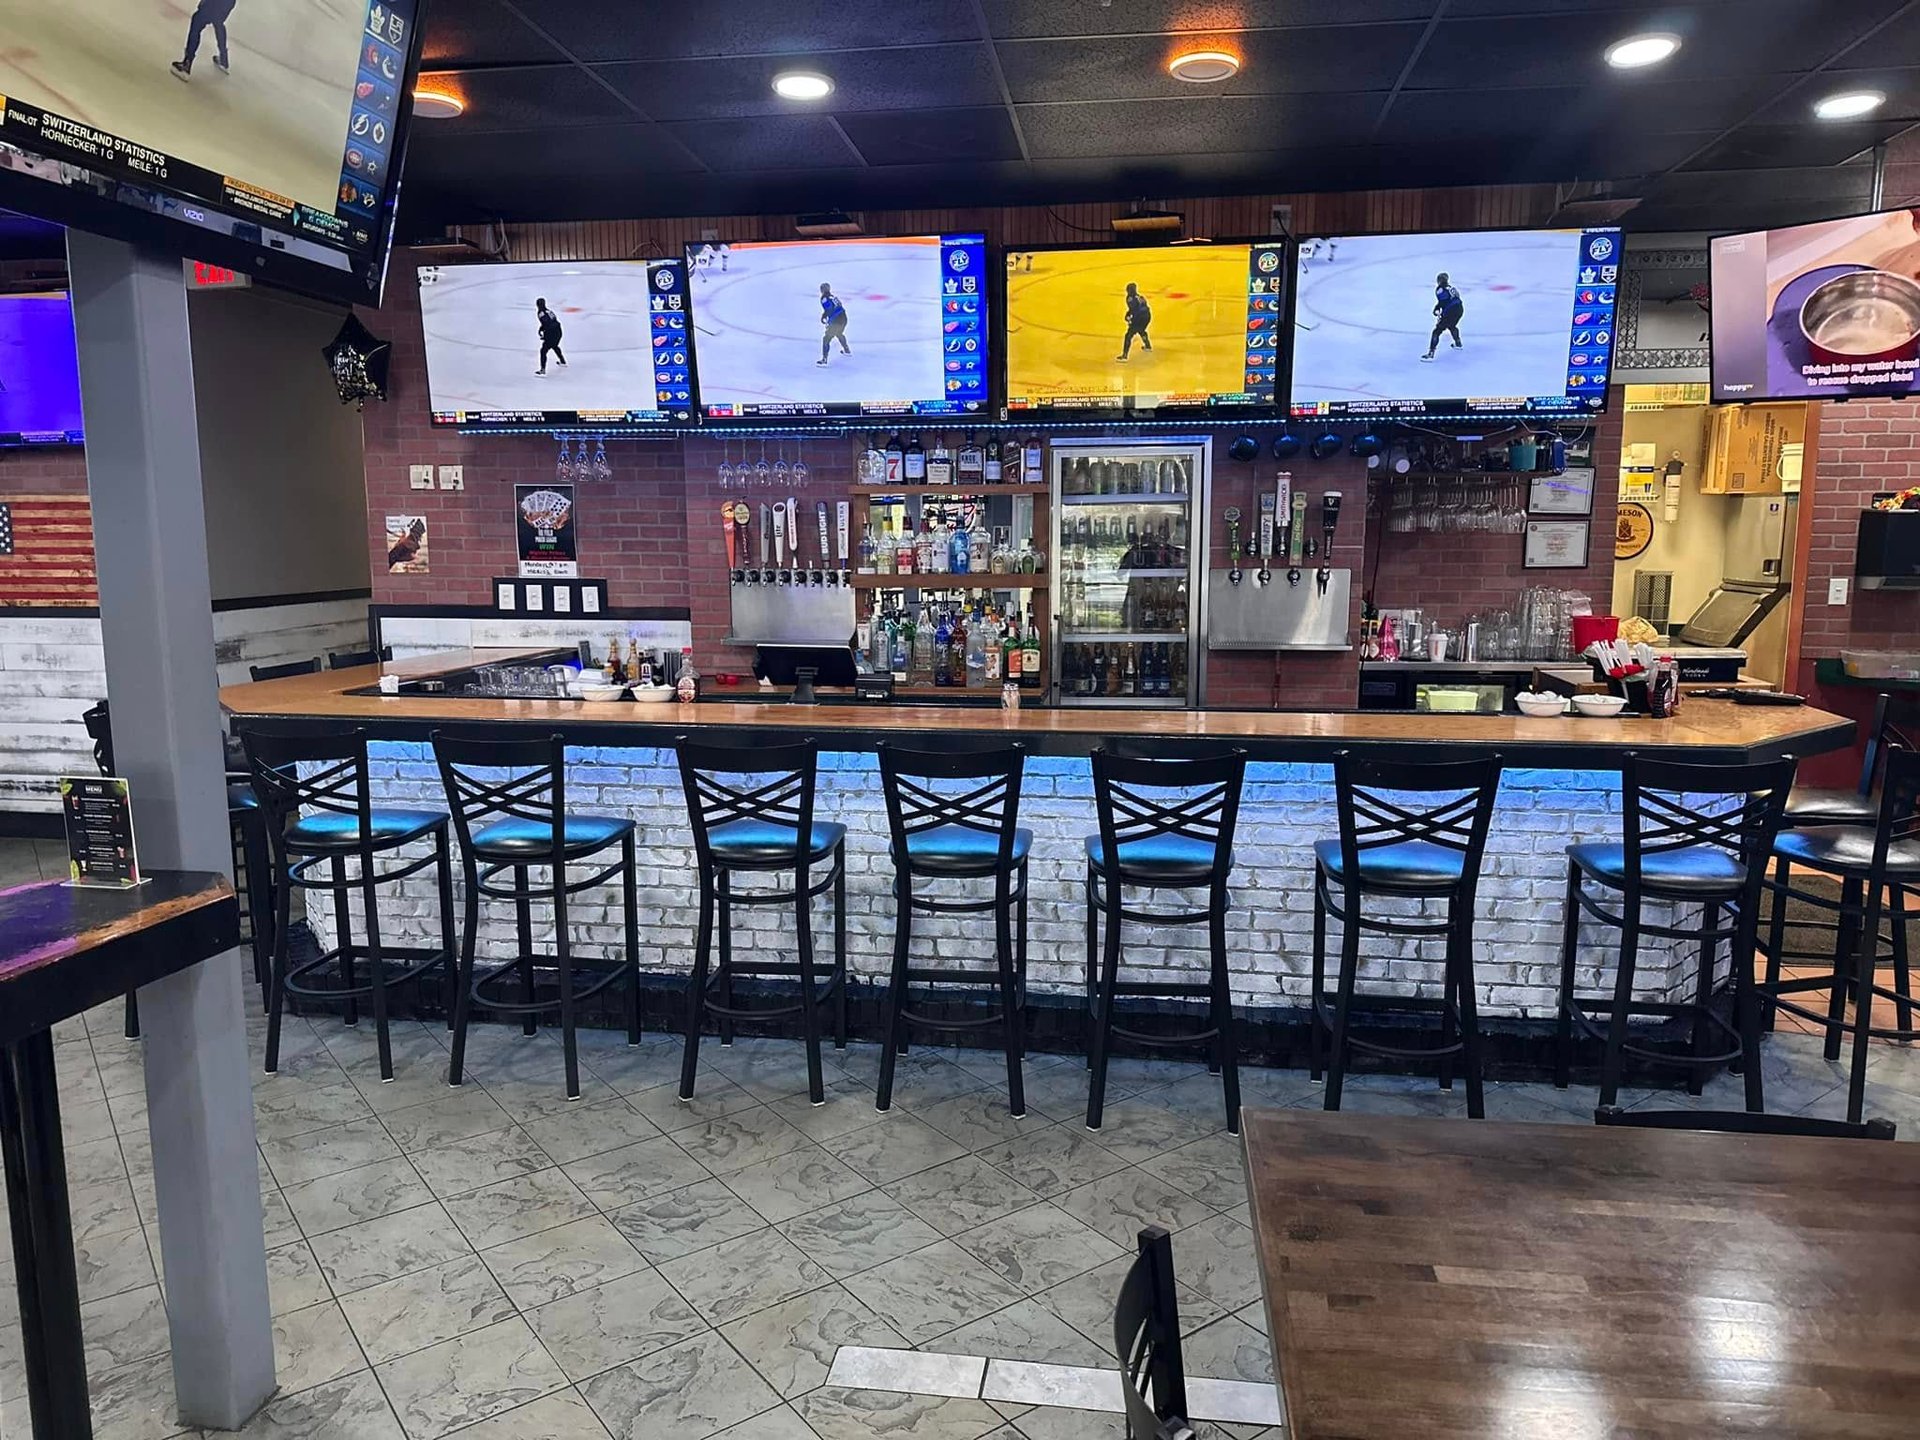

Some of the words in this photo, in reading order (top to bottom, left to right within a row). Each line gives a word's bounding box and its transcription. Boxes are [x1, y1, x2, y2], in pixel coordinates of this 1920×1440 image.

[42, 113, 113, 147] SWITZERLAND
[114, 139, 166, 166] STATISTICS
[40, 126, 98, 155] HORNECKER:
[100, 148, 105, 157] 1
[106, 150, 114, 160] G
[128, 156, 153, 173] MEILE:
[155, 167, 159, 176] 1
[160, 168, 168, 179] G
[183, 208, 204, 222] VIZIO
[1802, 364, 1831, 375] Diving
[1832, 363, 1850, 373] into
[1851, 363, 1867, 373] my
[1867, 361, 1895, 371] water
[1895, 358, 1920, 369] bowl
[1806, 377, 1818, 386] to
[1818, 376, 1849, 385] rescue
[1850, 373, 1890, 385] dropped
[1890, 371, 1914, 381] food
[887, 458, 900, 480] 7
[818, 511, 828, 535] LIGHT
[820, 535, 829, 554] BUD
